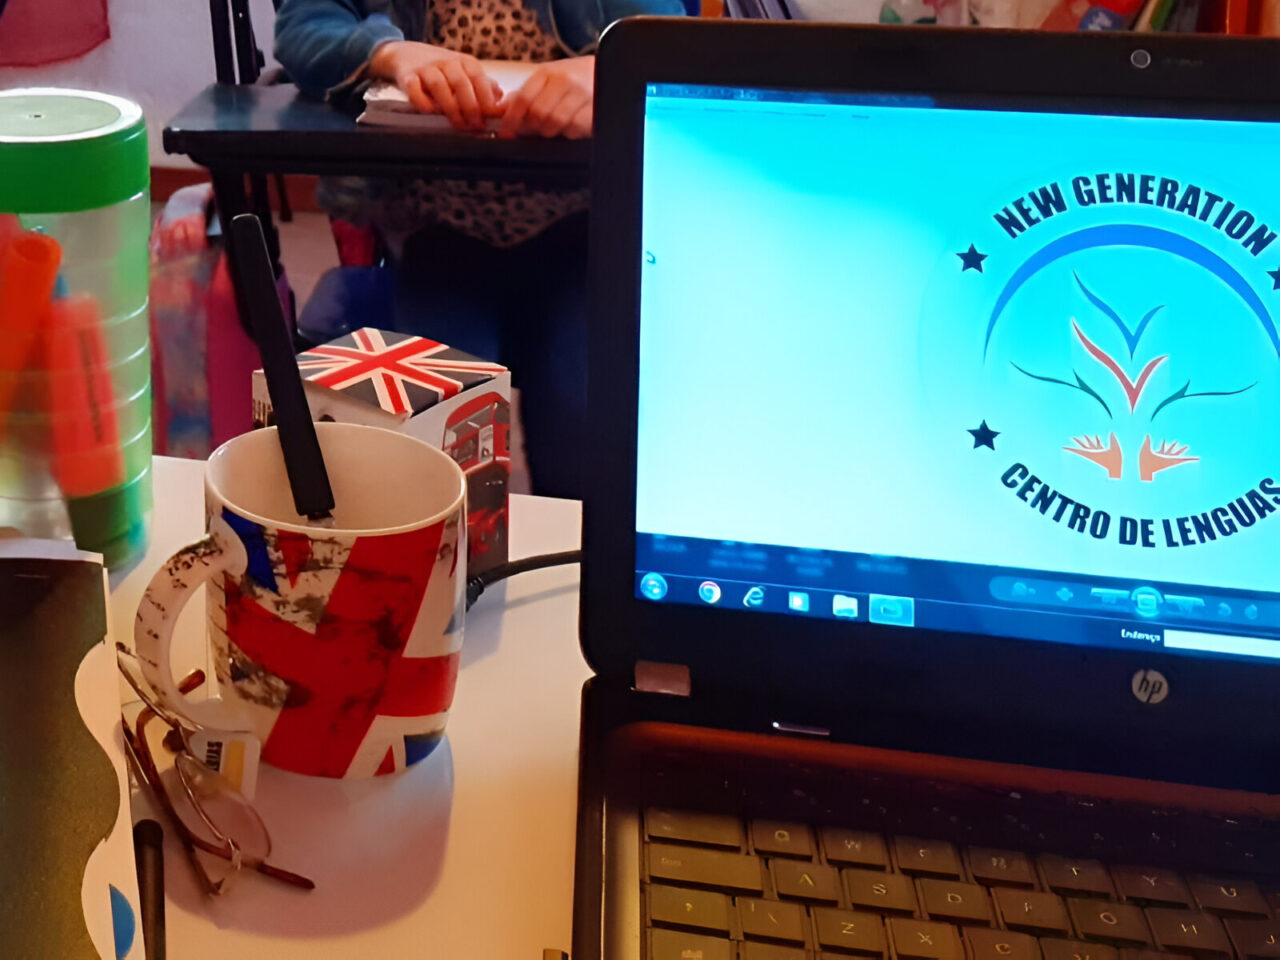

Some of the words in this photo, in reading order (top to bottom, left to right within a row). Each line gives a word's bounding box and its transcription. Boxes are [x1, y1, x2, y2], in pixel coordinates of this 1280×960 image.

[992, 181, 1068, 240] NEW
[1071, 172, 1278, 257] GENERATION
[1000, 462, 1111, 540] CENTRO
[1118, 516, 1156, 548] DE
[1162, 477, 1280, 548] LENGUAS
[1134, 669, 1167, 704] hp
